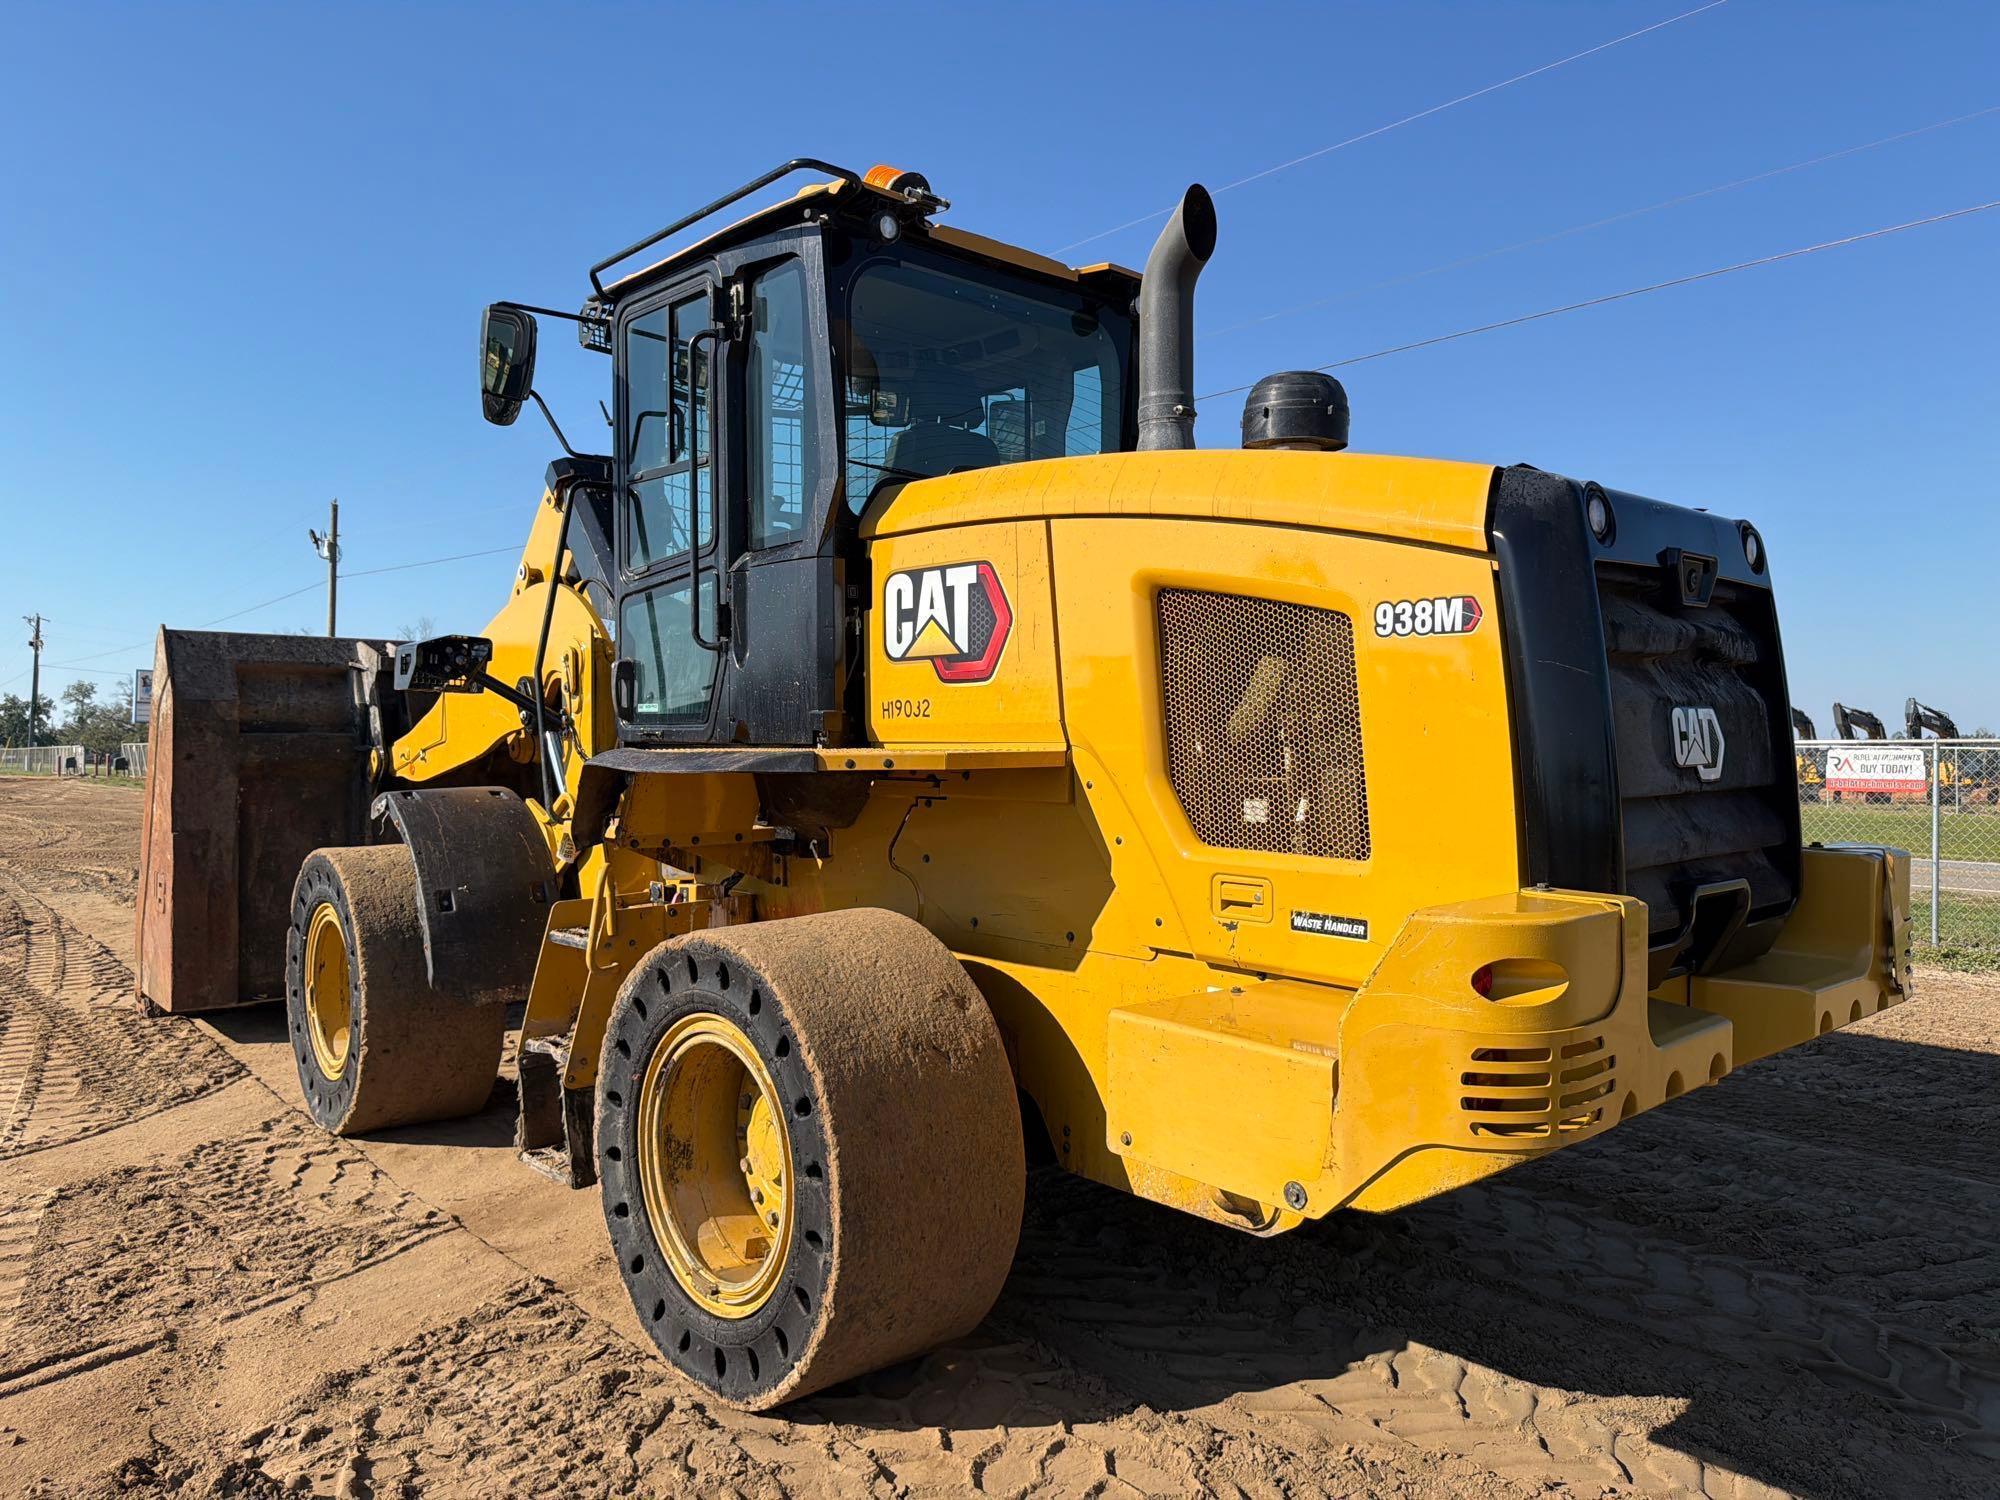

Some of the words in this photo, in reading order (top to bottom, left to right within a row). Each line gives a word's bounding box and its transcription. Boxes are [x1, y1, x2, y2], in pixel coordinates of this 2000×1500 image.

[885, 564, 977, 659] CAT
[1375, 597, 1463, 636] 938M
[1671, 707, 1714, 766] CAT
[1860, 764, 1878, 773] BUY
[1880, 764, 1913, 774] TODAY!
